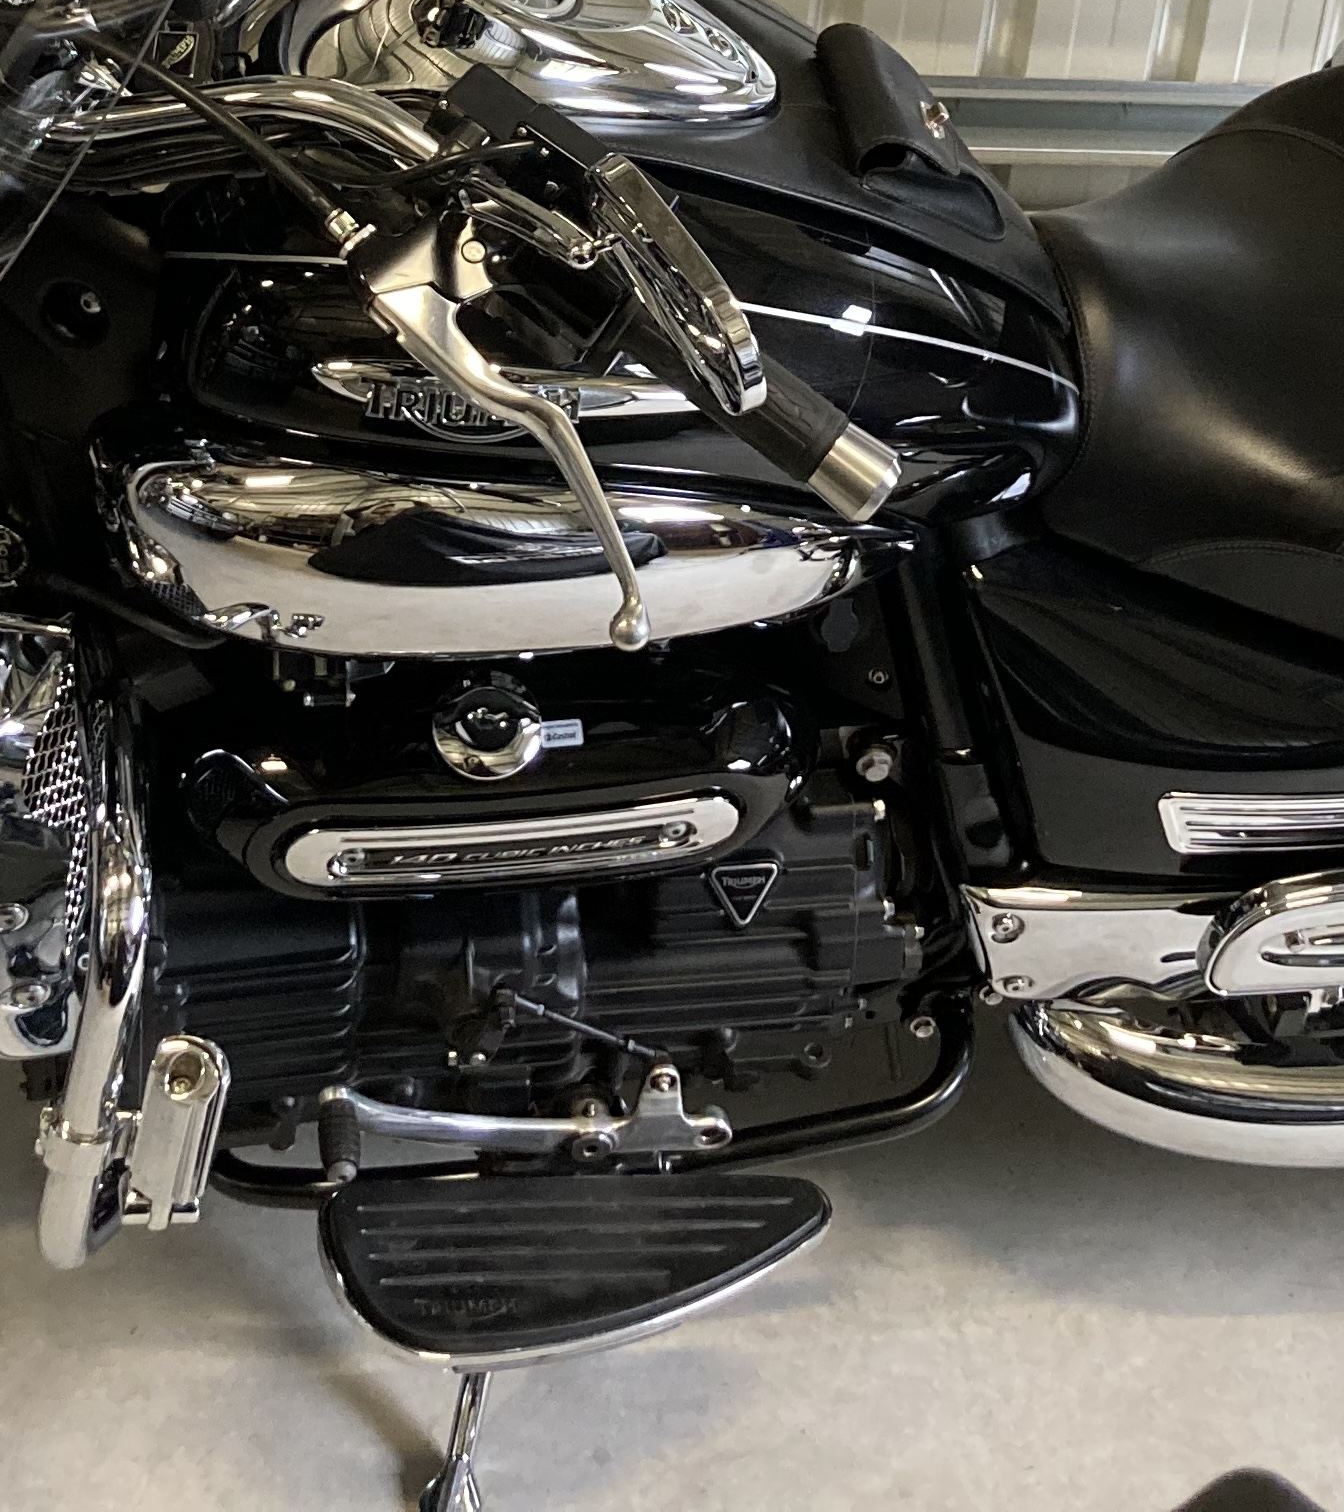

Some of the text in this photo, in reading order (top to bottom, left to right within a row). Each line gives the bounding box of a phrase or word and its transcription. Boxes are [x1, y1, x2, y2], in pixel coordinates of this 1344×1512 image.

[360, 376, 580, 434] TRIUH
[390, 852, 458, 866] 140
[548, 835, 647, 856] INCHES
[722, 875, 766, 889] TRIUMPH
